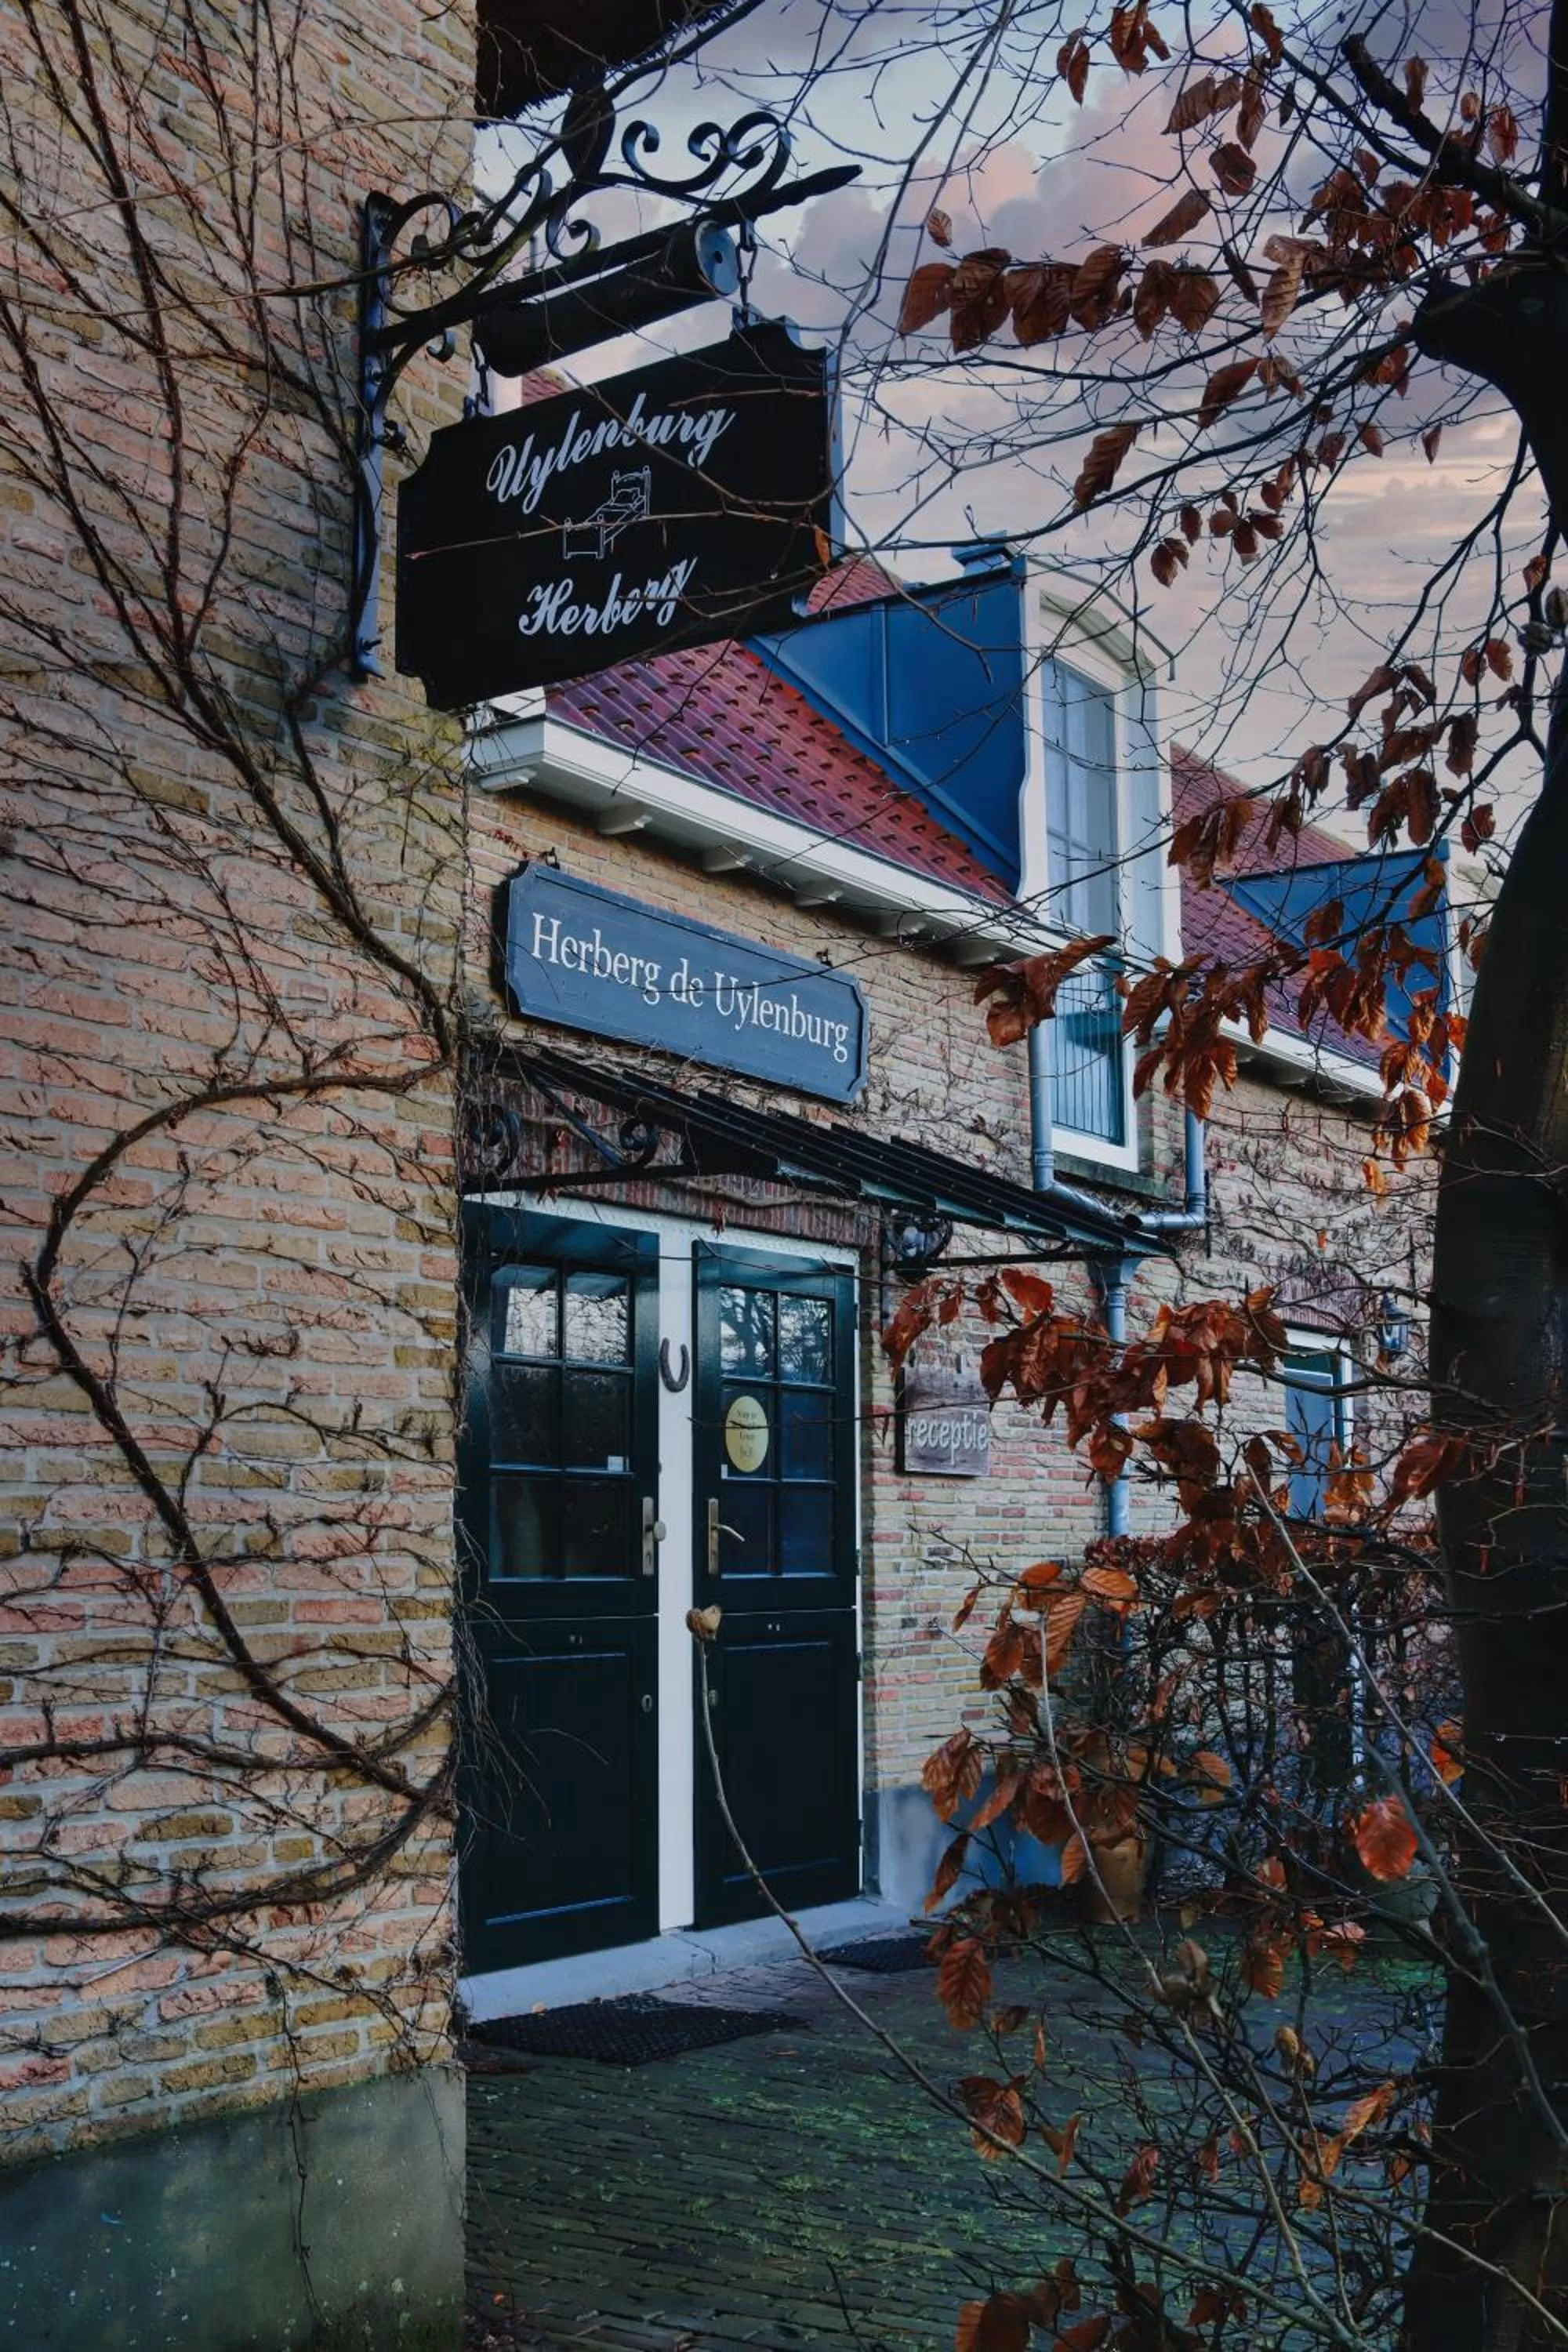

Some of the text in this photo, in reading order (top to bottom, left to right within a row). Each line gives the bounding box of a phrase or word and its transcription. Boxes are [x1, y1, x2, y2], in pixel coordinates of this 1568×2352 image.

[487, 393, 735, 514] Uylenburg
[518, 557, 699, 636] Herberg
[532, 913, 849, 1063] Herberg de Uylenburg
[906, 1412, 989, 1465] receptie
